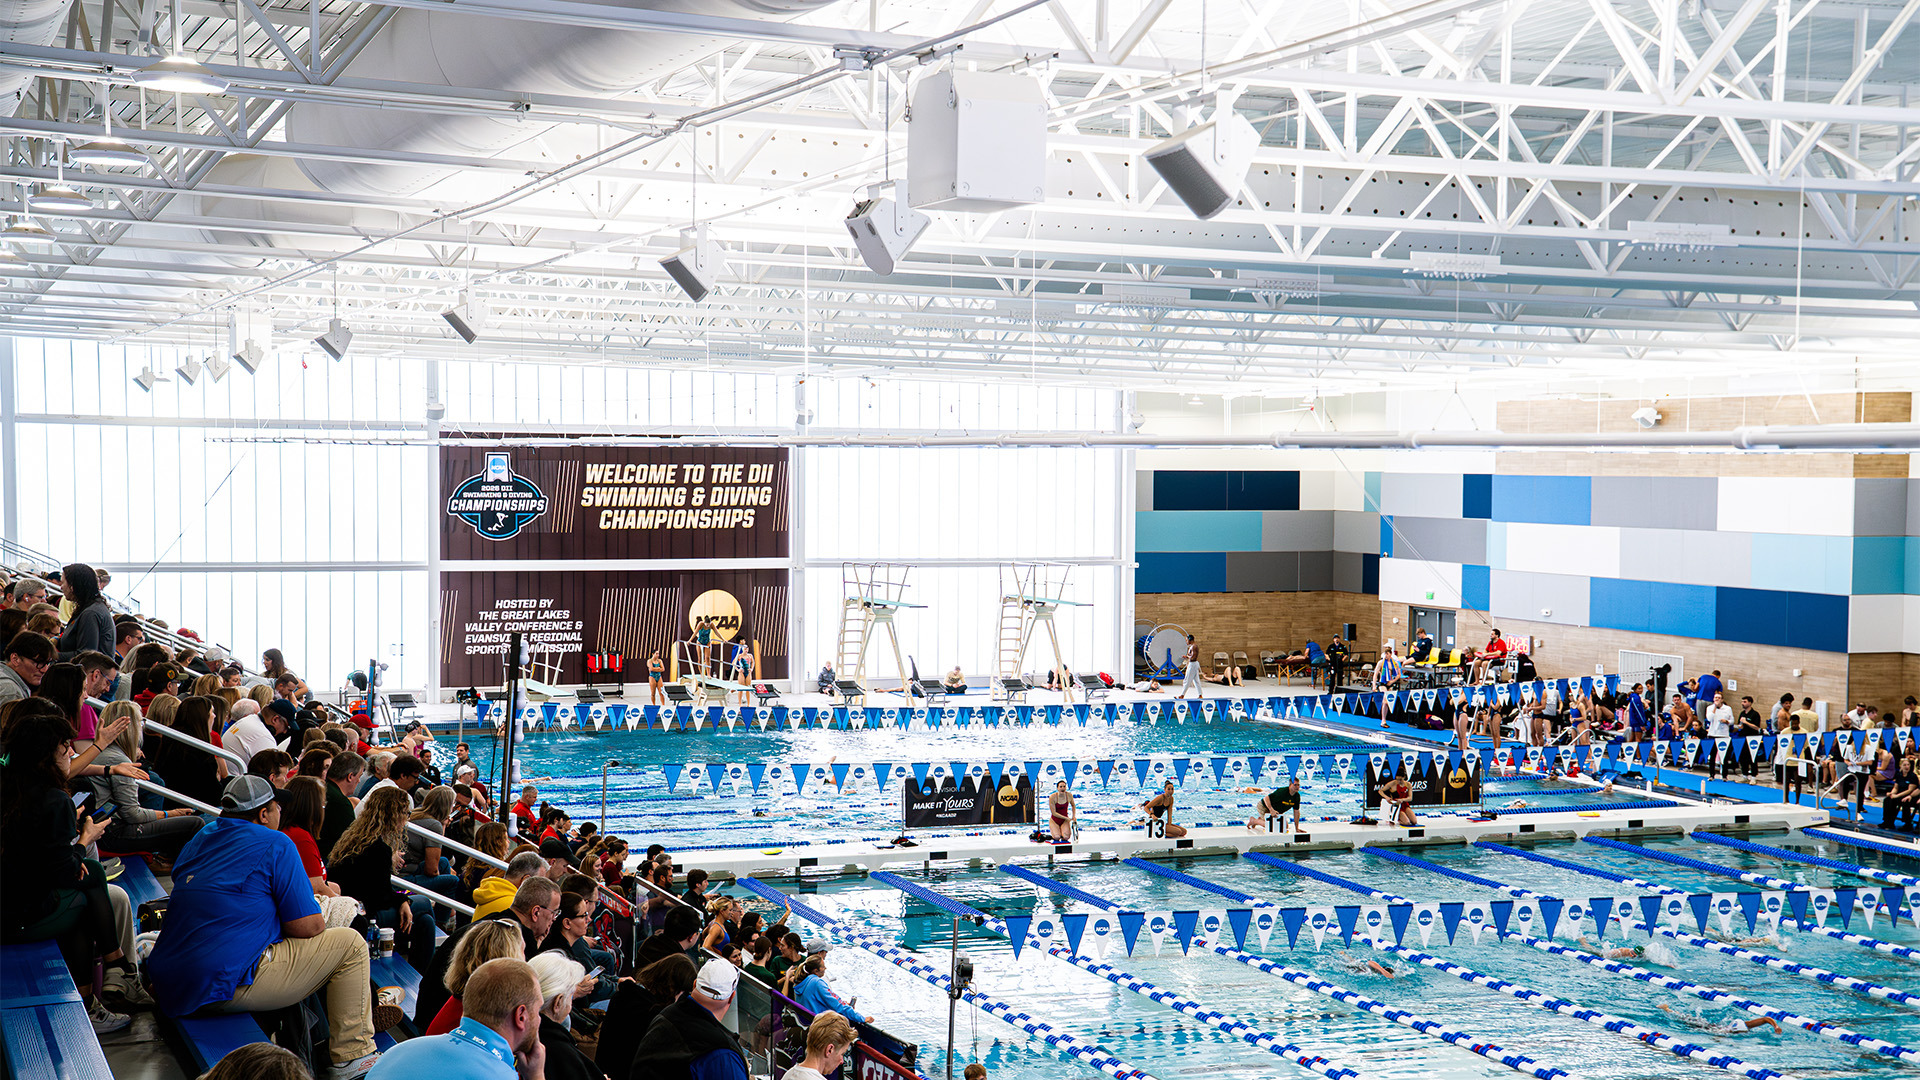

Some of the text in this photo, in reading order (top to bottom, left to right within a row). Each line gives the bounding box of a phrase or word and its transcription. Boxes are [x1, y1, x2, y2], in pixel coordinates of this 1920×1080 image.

[585, 463, 774, 484] WELCOME TO THE DII
[580, 486, 772, 507] SWIMMING & DIVING
[450, 499, 545, 511] CHAMPIONSHIPS
[599, 509, 756, 530] CHAMPIONSHIPS
[495, 599, 554, 609] HOSTED BY
[478, 610, 570, 620] THE GREAT LAKES
[465, 621, 583, 632] VALLEY CONFERENCE &
[465, 632, 583, 643] EVANSVIE REGIONAL
[465, 643, 583, 655] SPORTS MMISSION
[1509, 661, 1516, 671] 4
[912, 796, 974, 811] MAKE IT YOURS
[1146, 819, 1164, 838] 13
[1266, 815, 1284, 833] 11
